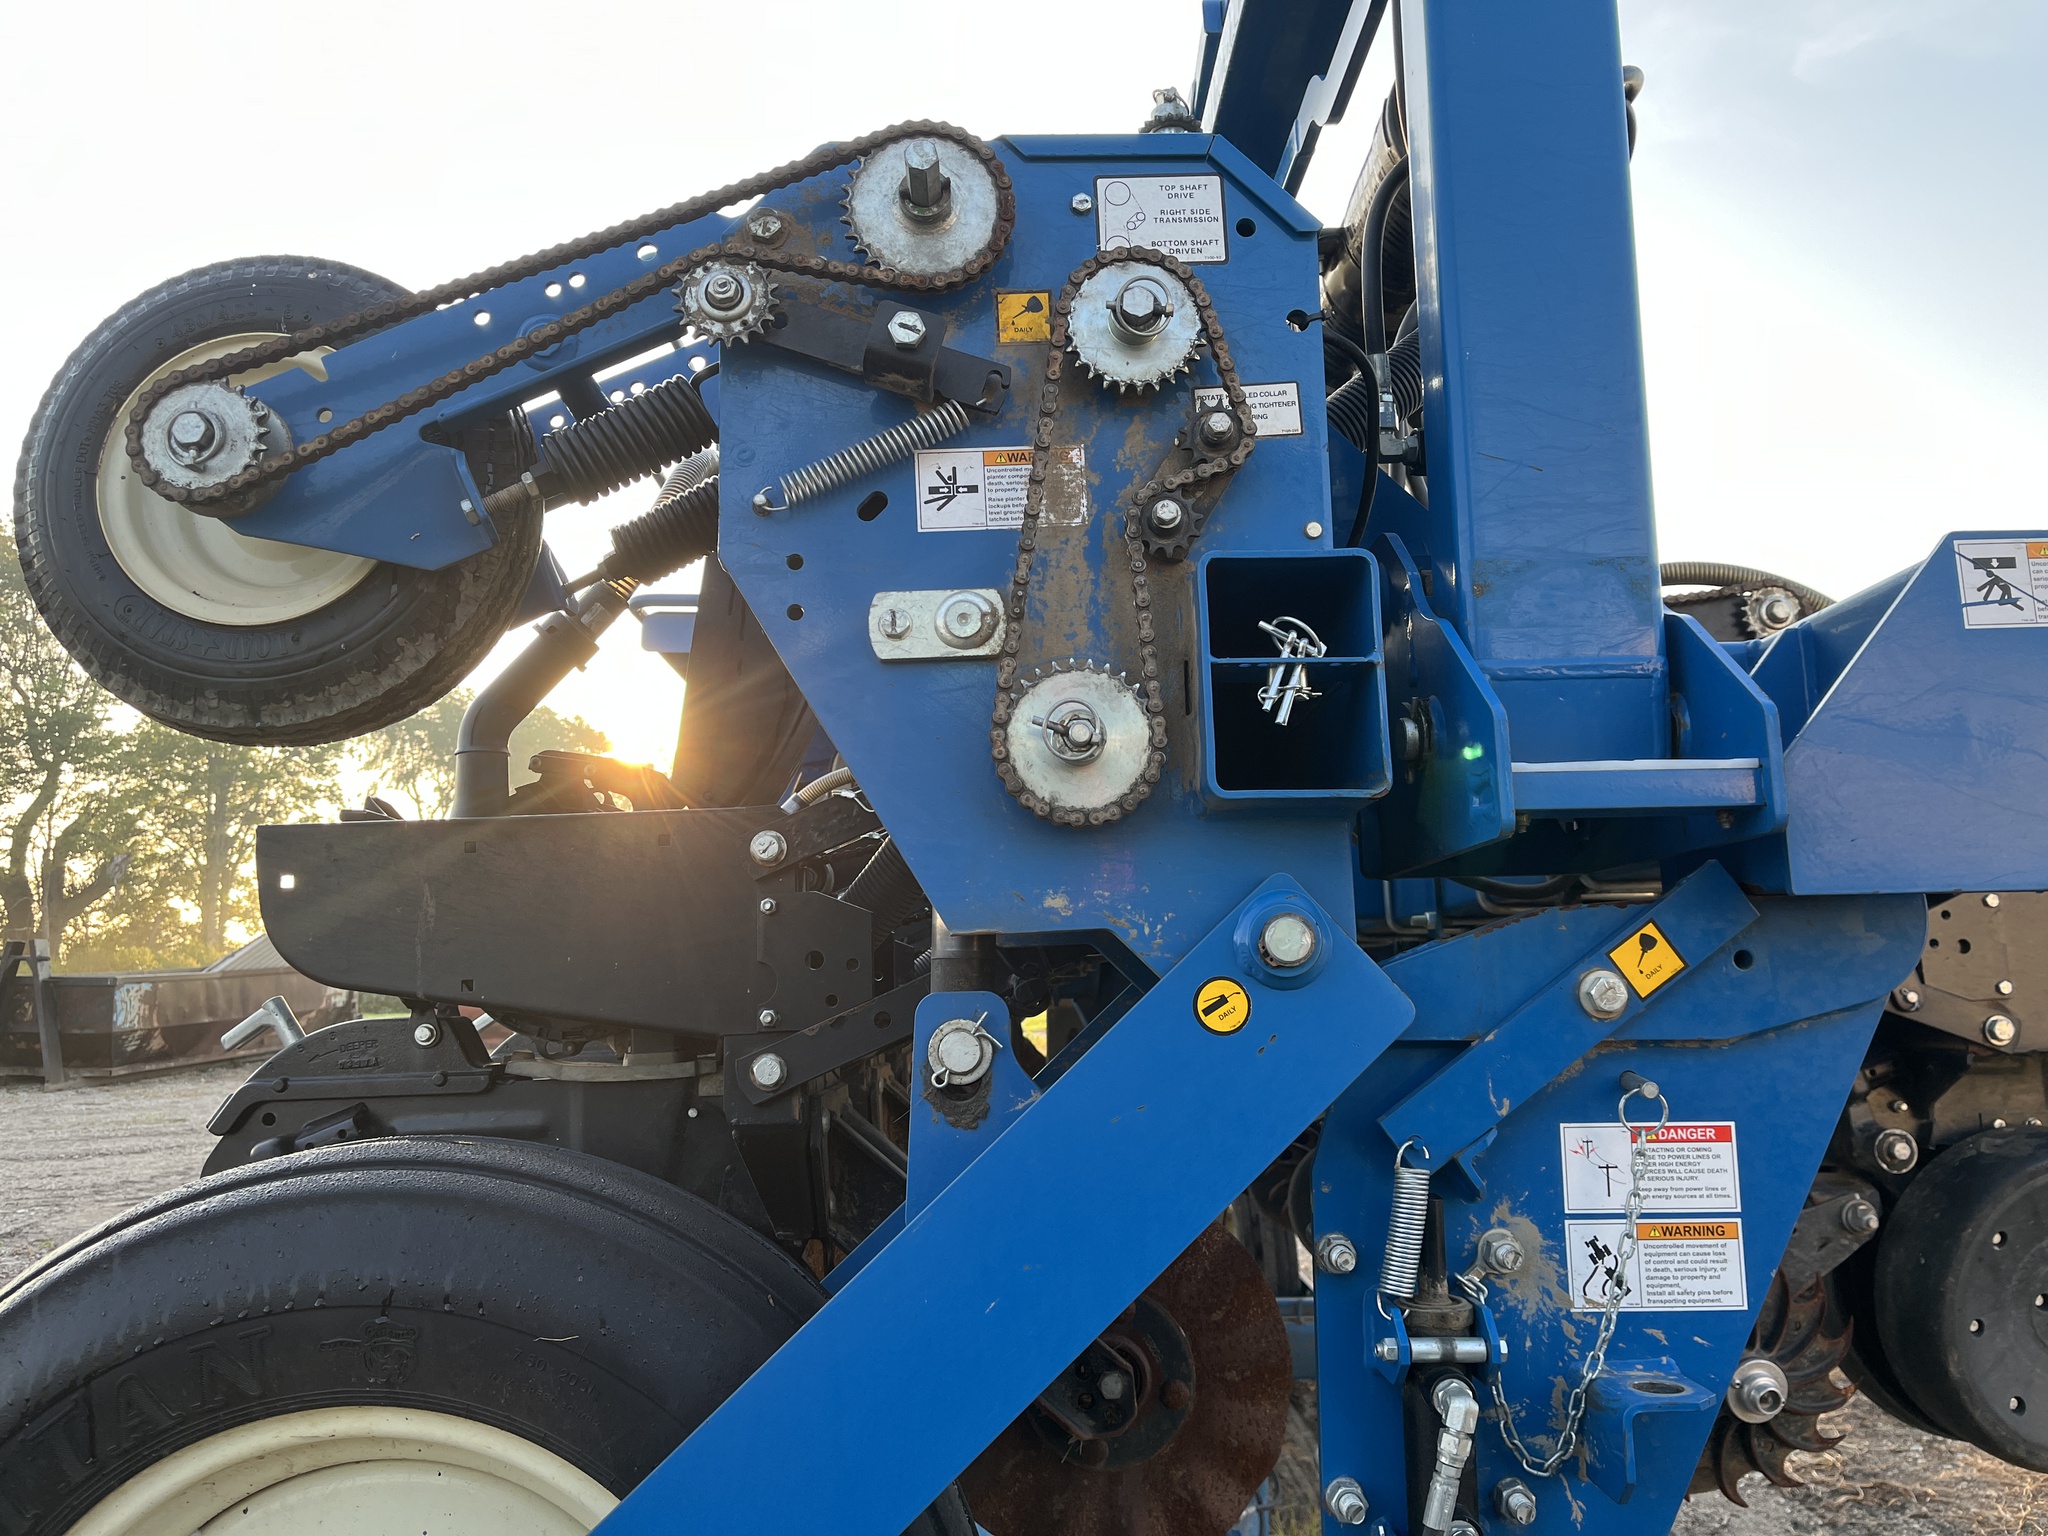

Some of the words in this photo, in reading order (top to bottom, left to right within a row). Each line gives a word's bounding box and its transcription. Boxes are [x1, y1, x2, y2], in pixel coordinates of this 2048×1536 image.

[1153, 216, 1219, 224] TRANSMISSION
[1168, 247, 1203, 255] DRIVEN
[1259, 390, 1288, 398] COLLAR
[1259, 401, 1296, 409] TIGHTENER
[1645, 964, 1663, 980] DAILY
[1218, 1005, 1237, 1021] DAILY
[340, 1039, 378, 1053] DEEPER
[1658, 1128, 1716, 1140] DANGER
[1661, 1225, 1725, 1237] WARNING
